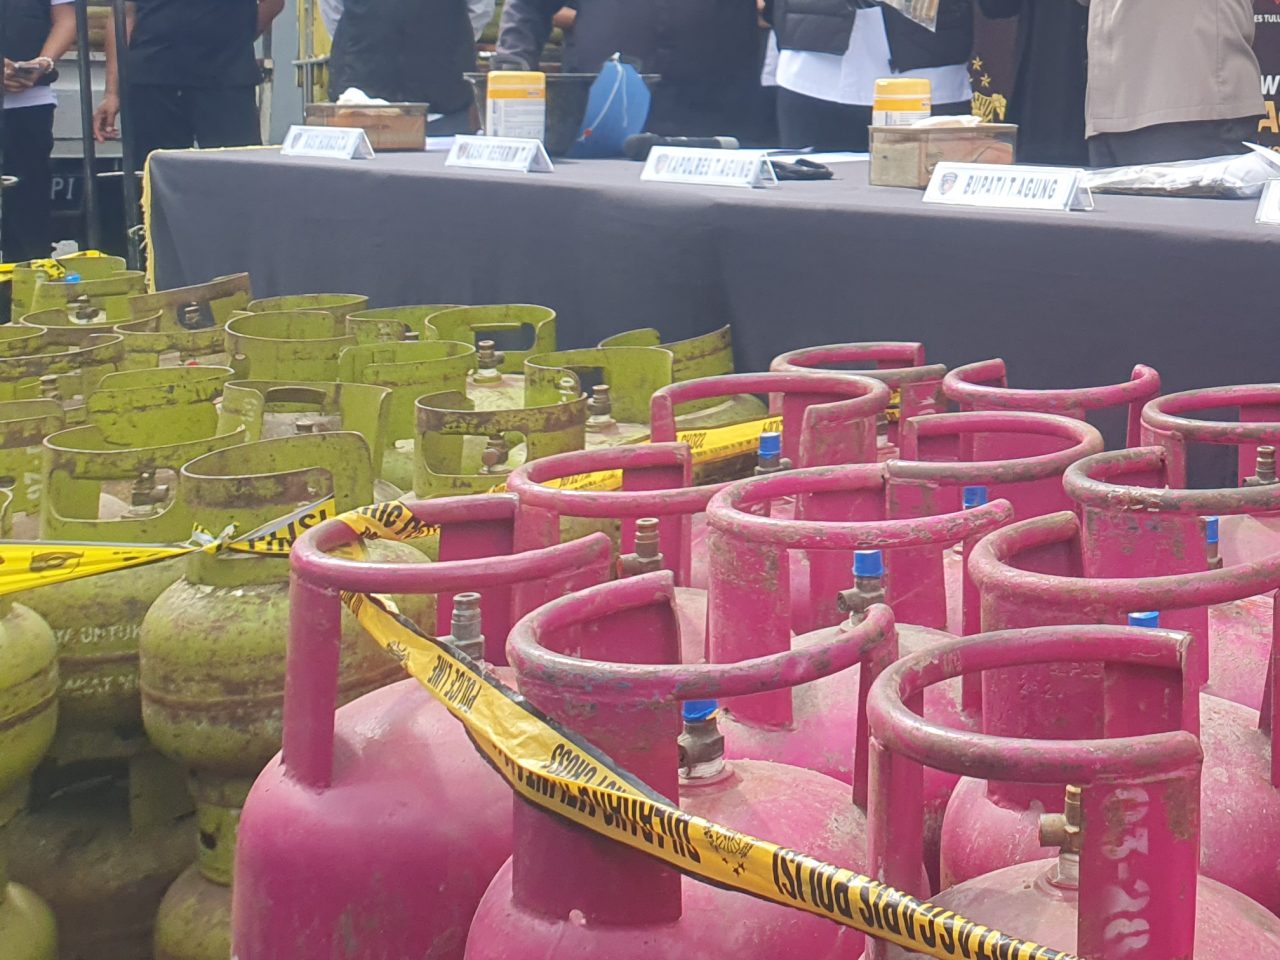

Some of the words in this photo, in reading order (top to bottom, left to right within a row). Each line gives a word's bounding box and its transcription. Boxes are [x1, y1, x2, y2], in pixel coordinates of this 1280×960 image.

[426, 655, 453, 690] LINE
[448, 666, 483, 714] POLICE
[771, 846, 850, 920] POLISI
